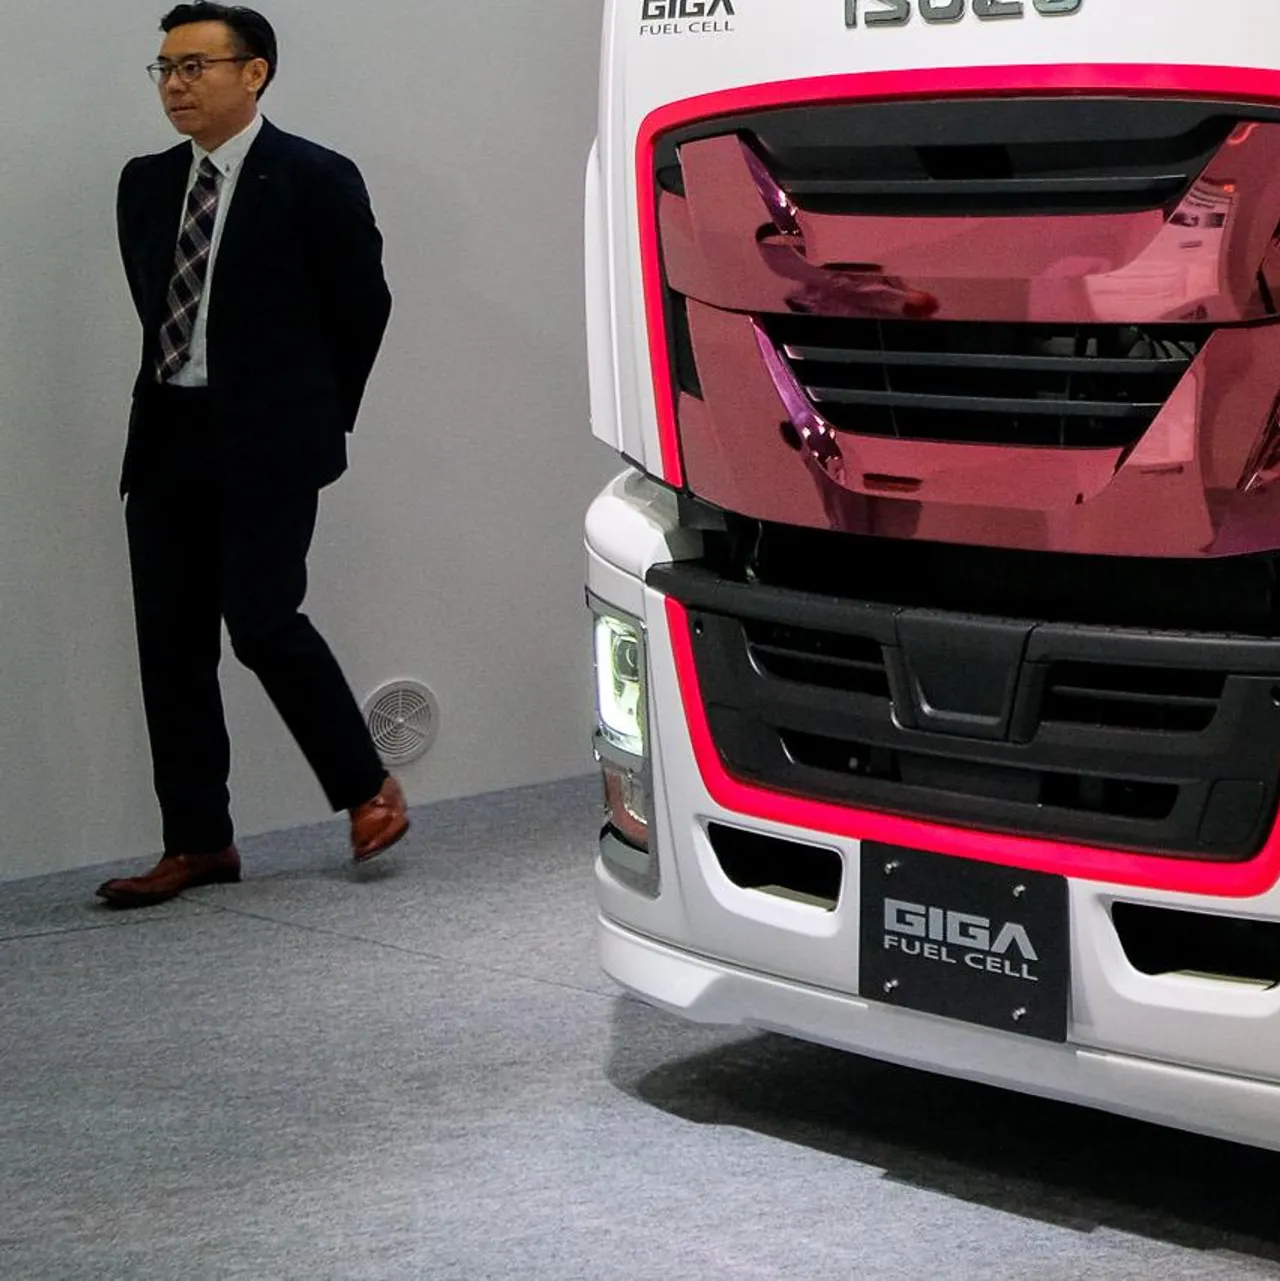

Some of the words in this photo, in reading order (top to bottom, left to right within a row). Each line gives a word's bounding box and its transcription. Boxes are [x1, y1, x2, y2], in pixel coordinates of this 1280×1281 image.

[640, 23, 683, 35] FUEL
[688, 20, 736, 33] CELL
[884, 897, 1039, 962] GIGA
[883, 934, 957, 964] FUEL
[963, 952, 1039, 982] CELL
